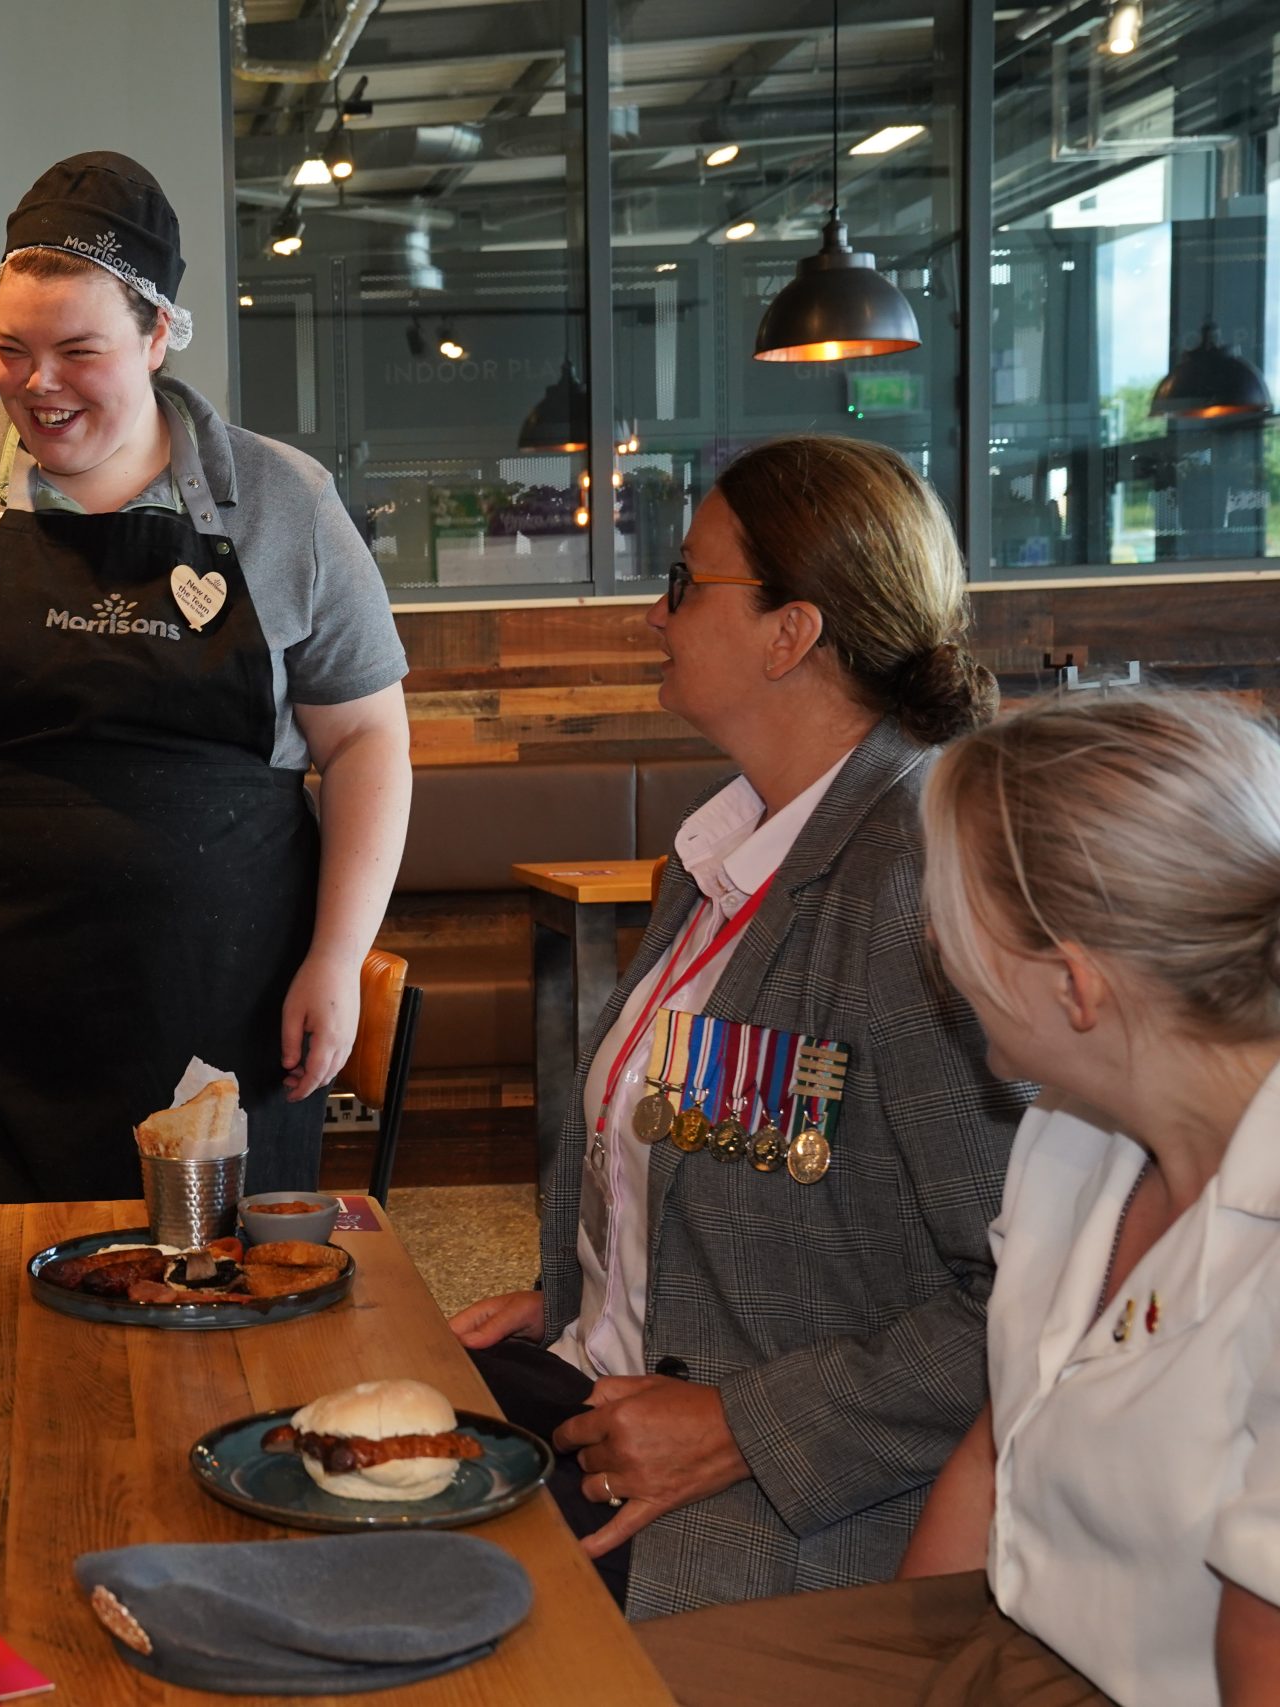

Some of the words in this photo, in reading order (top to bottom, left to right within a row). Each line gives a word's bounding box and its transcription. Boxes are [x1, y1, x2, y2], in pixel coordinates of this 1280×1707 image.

[63, 235, 138, 278] Morrisons
[178, 585, 191, 597] the
[191, 595, 210, 615] Team
[186, 579, 203, 596] New
[203, 594, 212, 604] to
[46, 608, 181, 641] Morrisons
